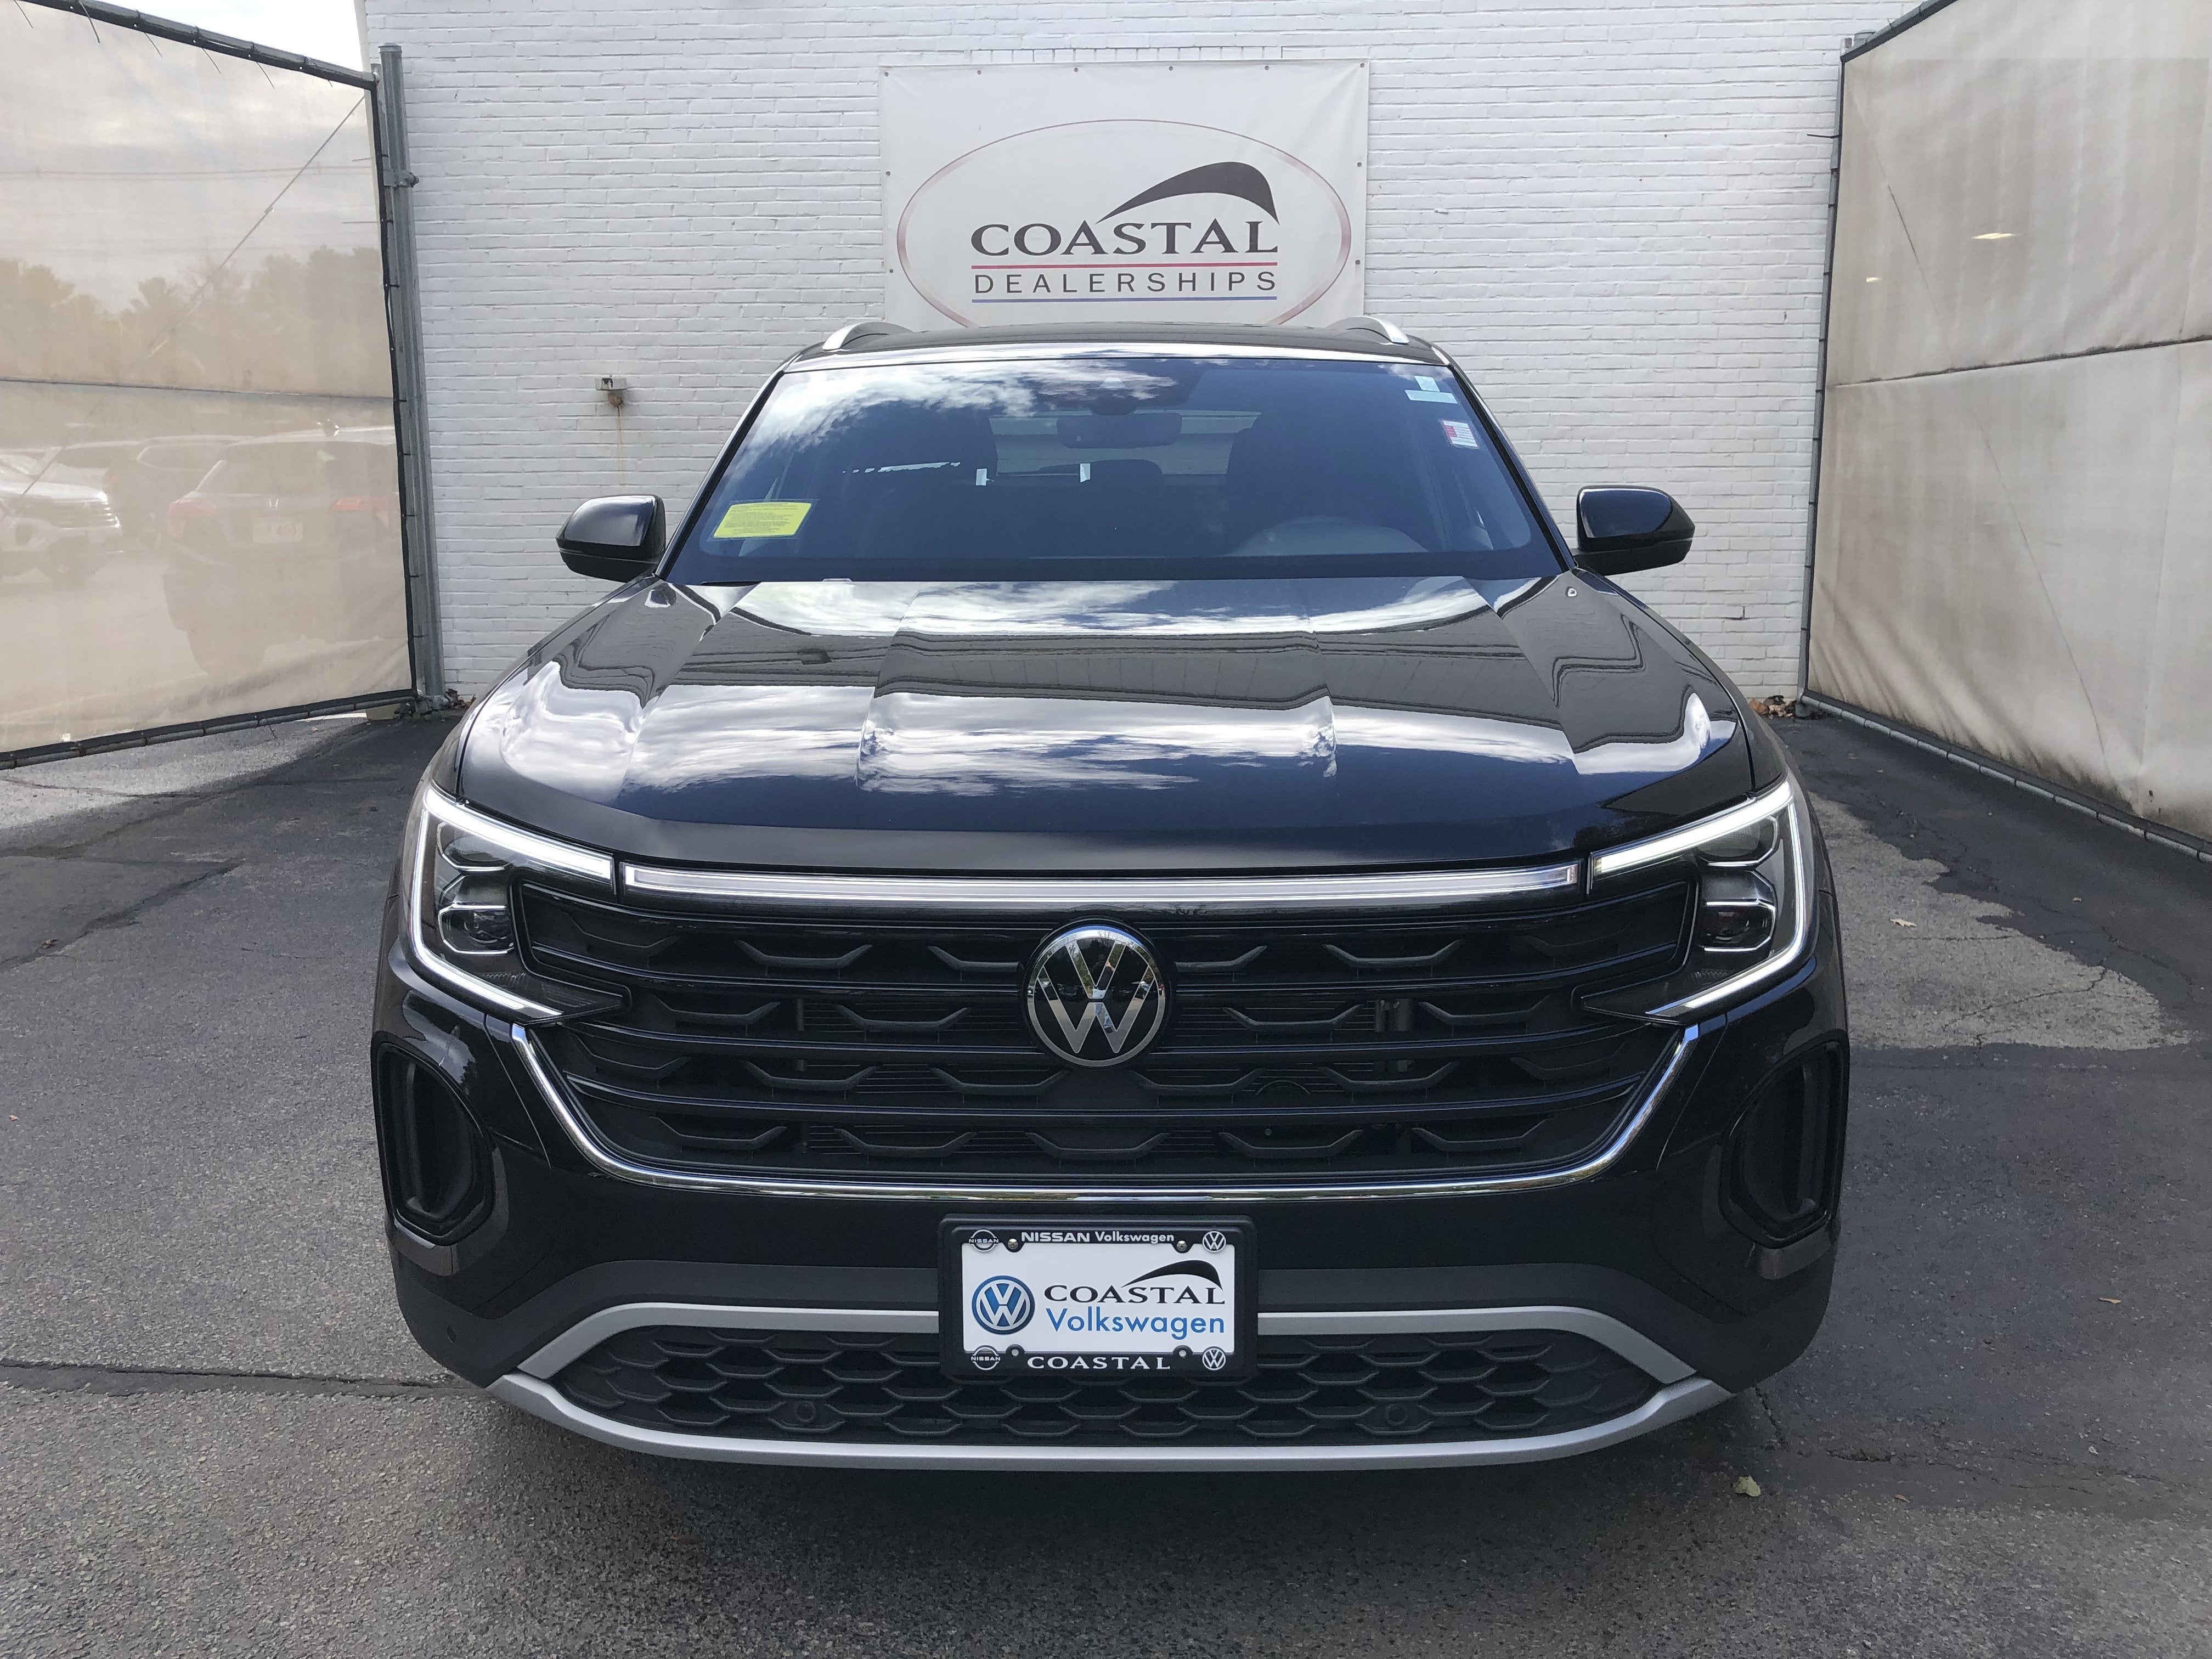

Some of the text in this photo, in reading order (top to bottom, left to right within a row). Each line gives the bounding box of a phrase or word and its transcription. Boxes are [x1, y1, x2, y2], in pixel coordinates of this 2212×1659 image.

[970, 217, 1279, 256] COASTAL
[974, 271, 1276, 294] DEALERSHIPS
[1021, 1231, 1175, 1244] NISSAN Volkswagen
[1044, 1284, 1226, 1305] COASTAL
[1045, 1306, 1224, 1340] Volkswagen
[1027, 1356, 1170, 1370] COASTAL
